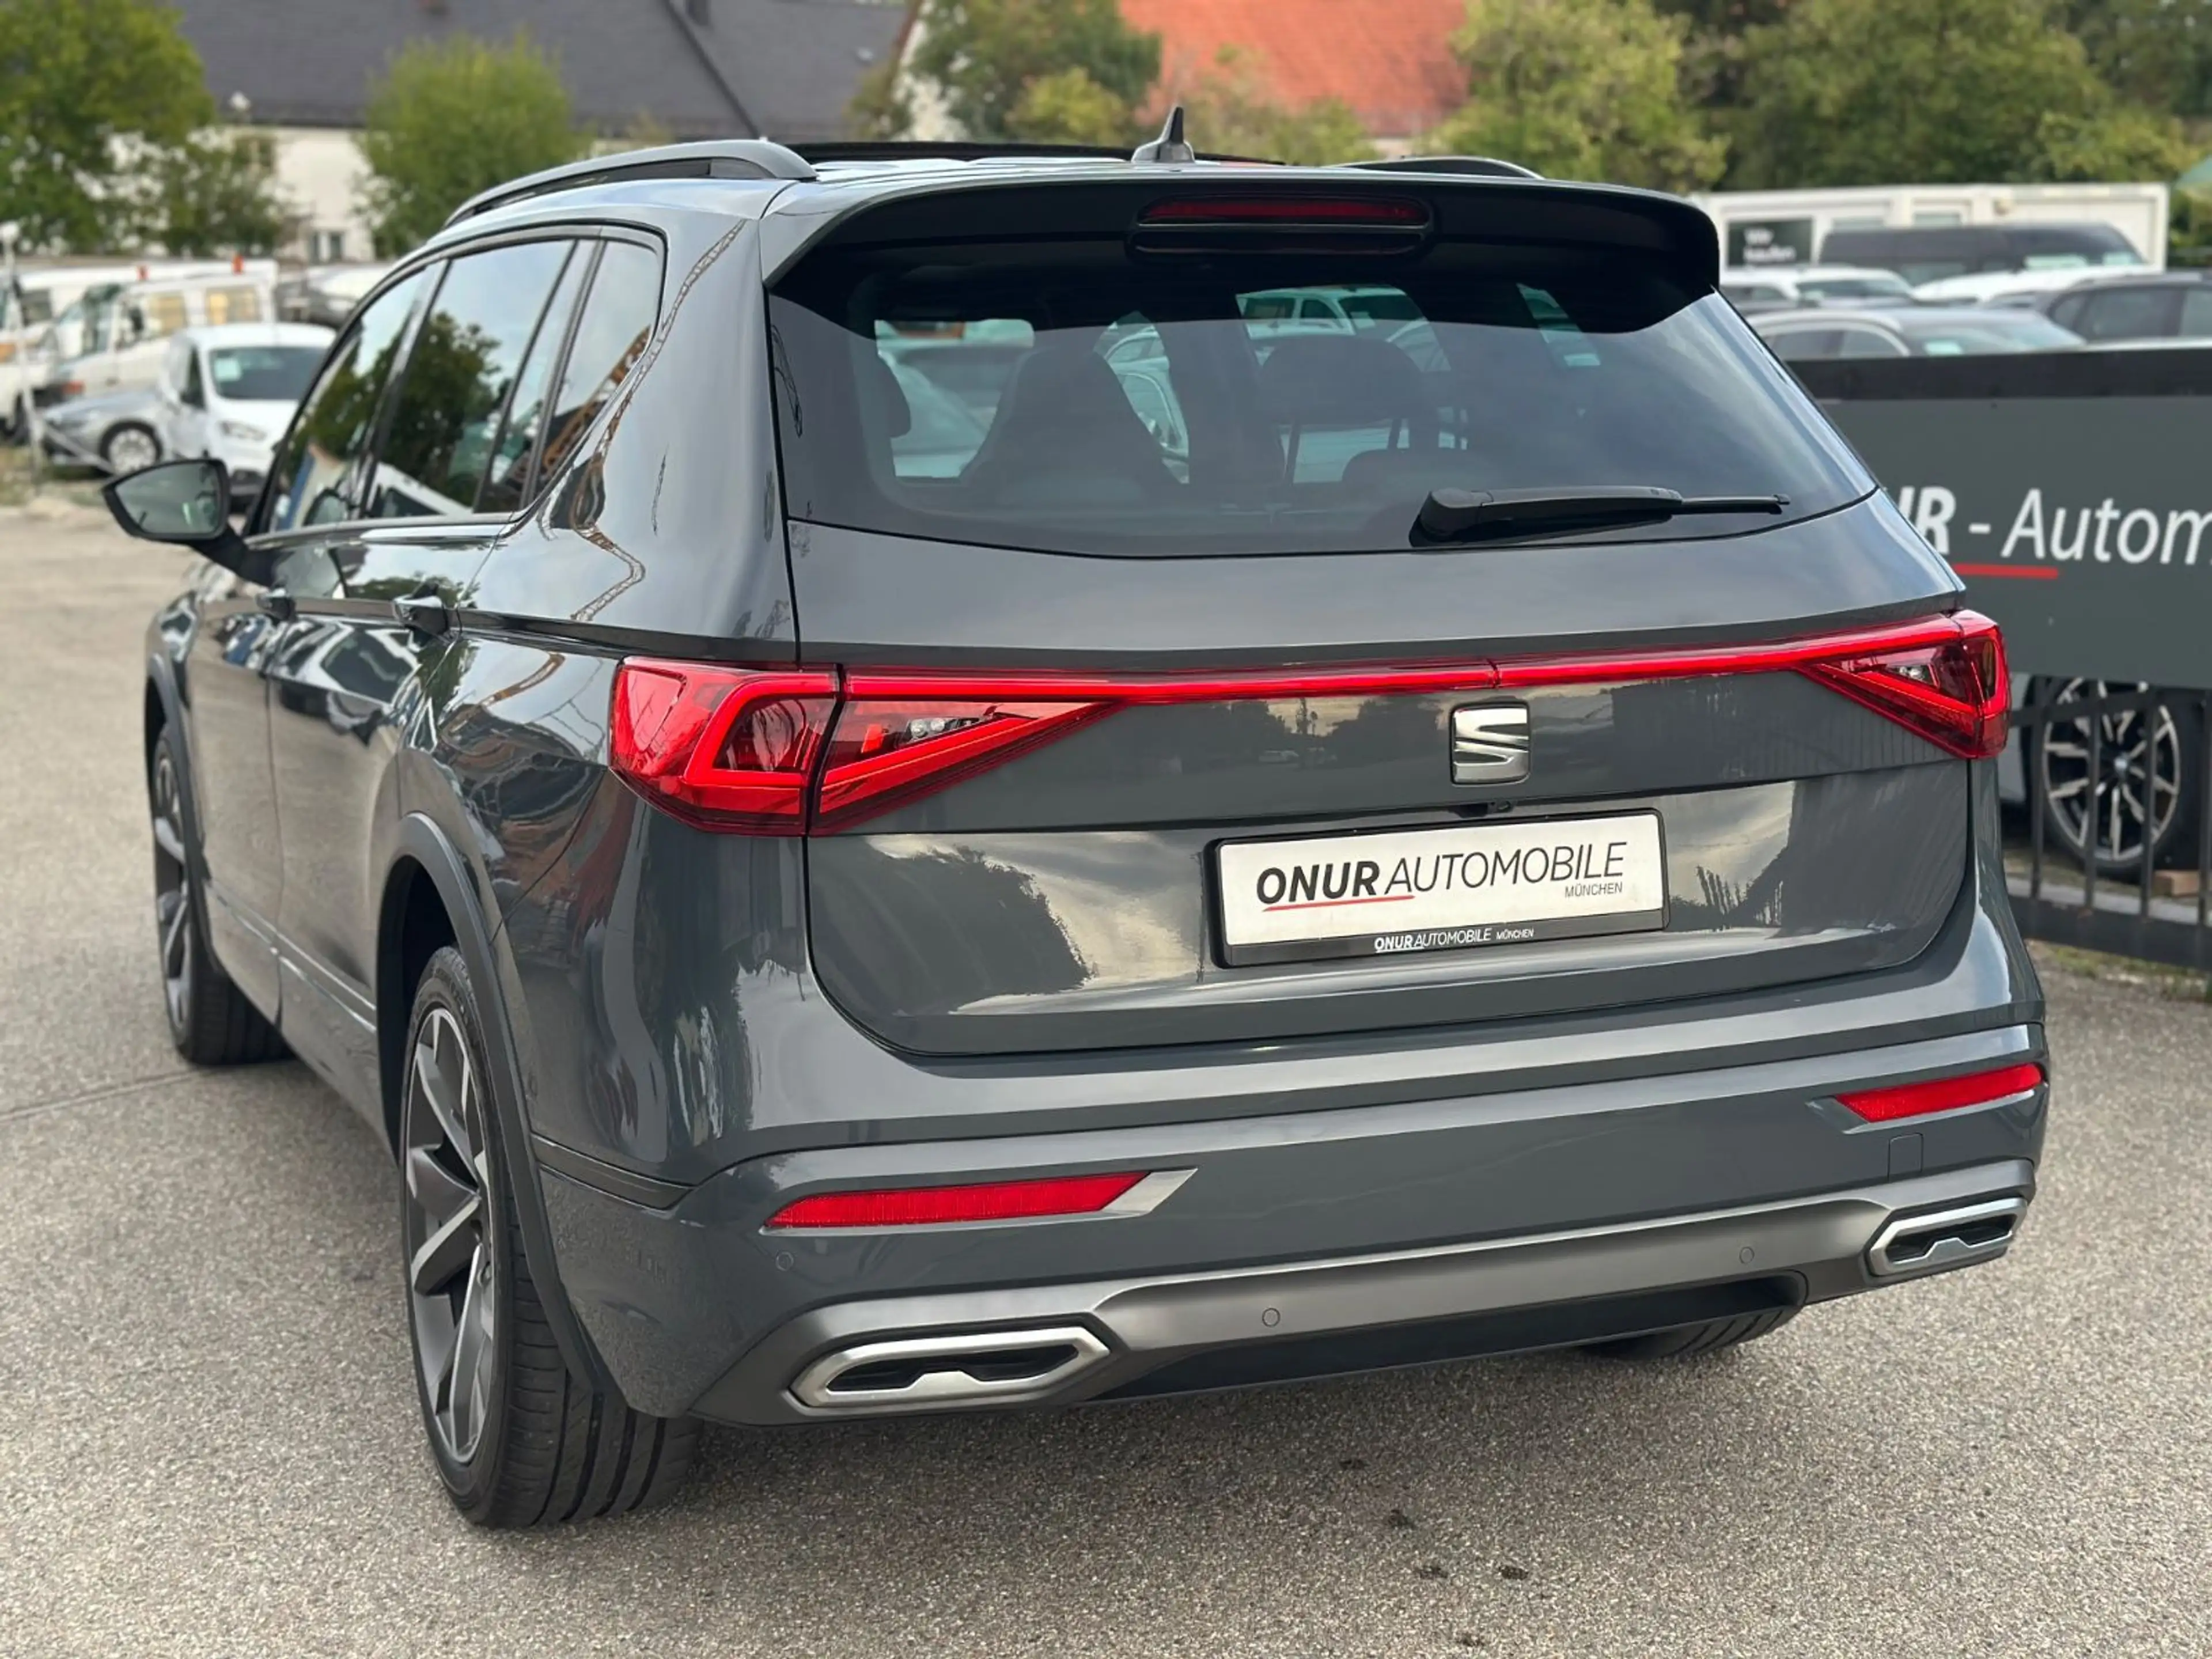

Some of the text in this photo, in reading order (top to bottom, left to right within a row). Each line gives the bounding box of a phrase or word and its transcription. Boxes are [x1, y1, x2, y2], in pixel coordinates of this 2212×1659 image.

[2001, 488, 2212, 565] Autom
[1256, 842, 1627, 905] ONUR AUTOMOBILE
[1564, 881, 1623, 898] MÜNCHEN
